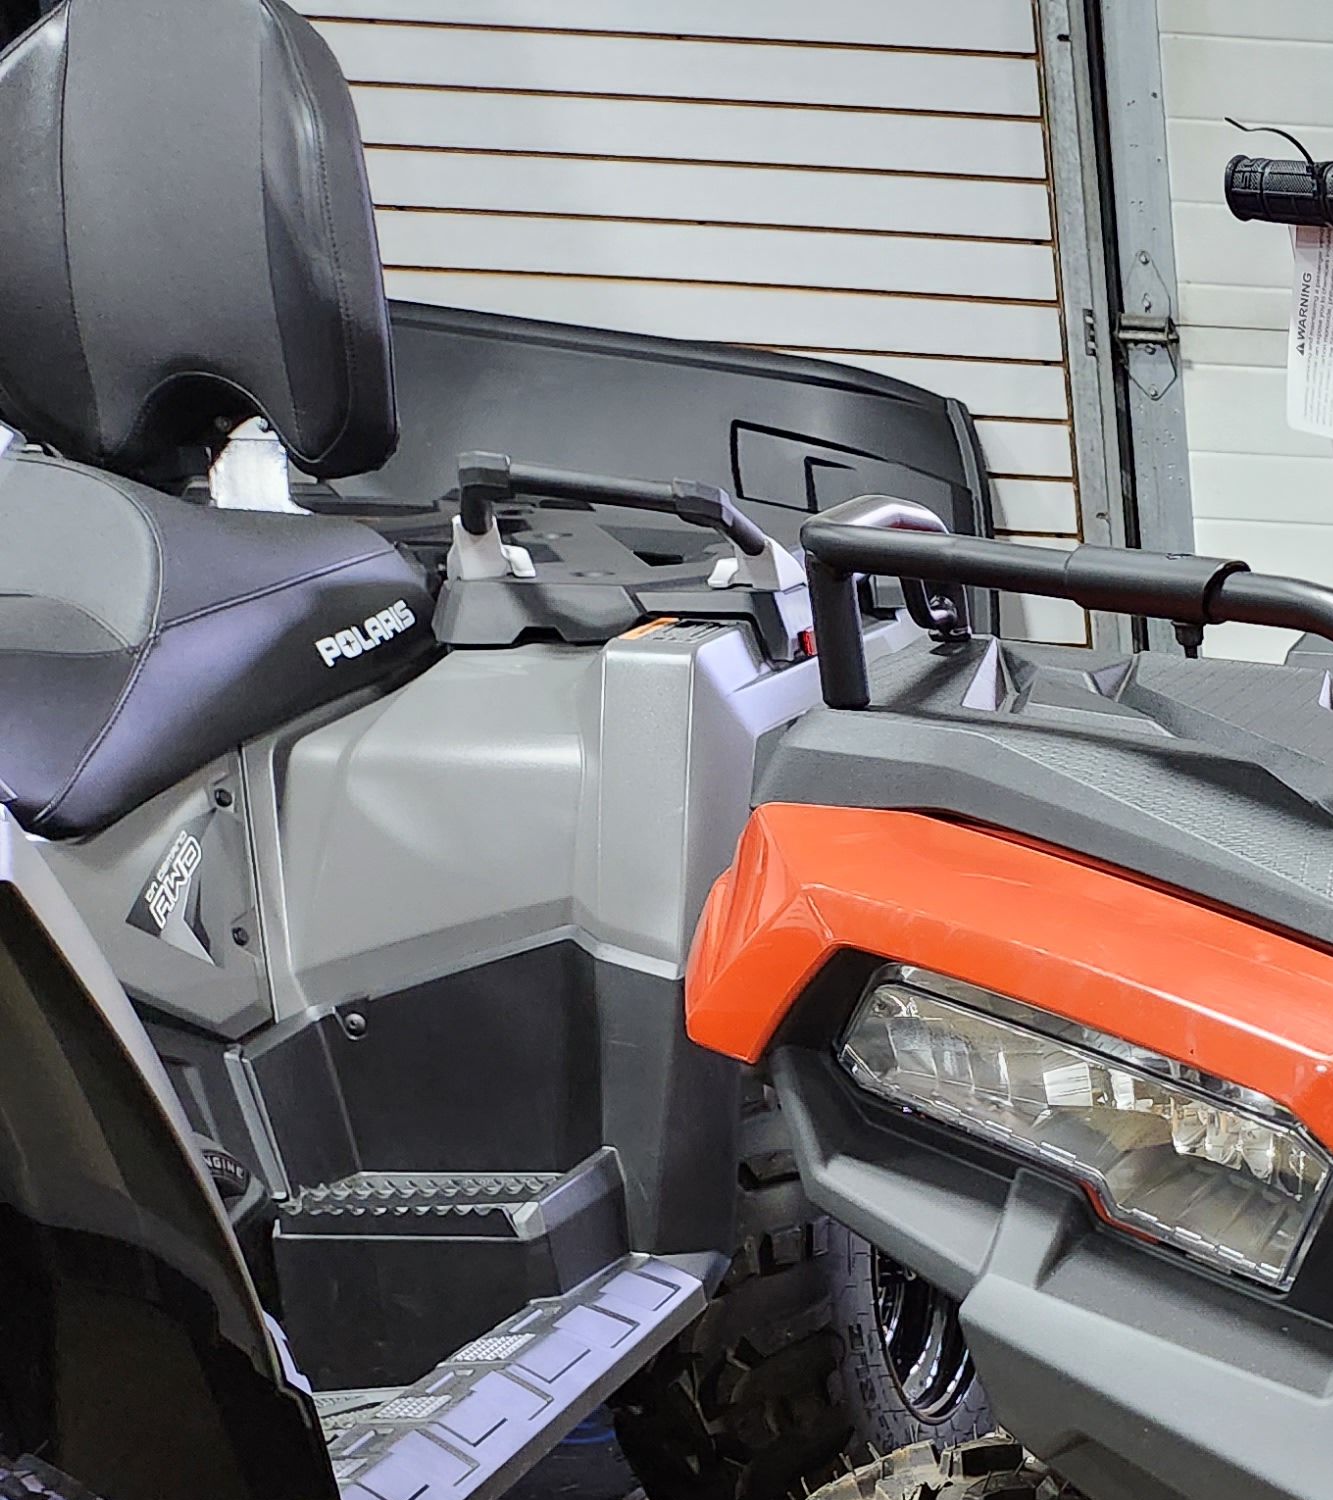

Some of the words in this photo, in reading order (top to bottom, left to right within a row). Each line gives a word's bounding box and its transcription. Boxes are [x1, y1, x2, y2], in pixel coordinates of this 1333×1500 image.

[1297, 272, 1311, 340] WARNING
[314, 599, 416, 668] POLARIS
[148, 835, 202, 930] AWD
